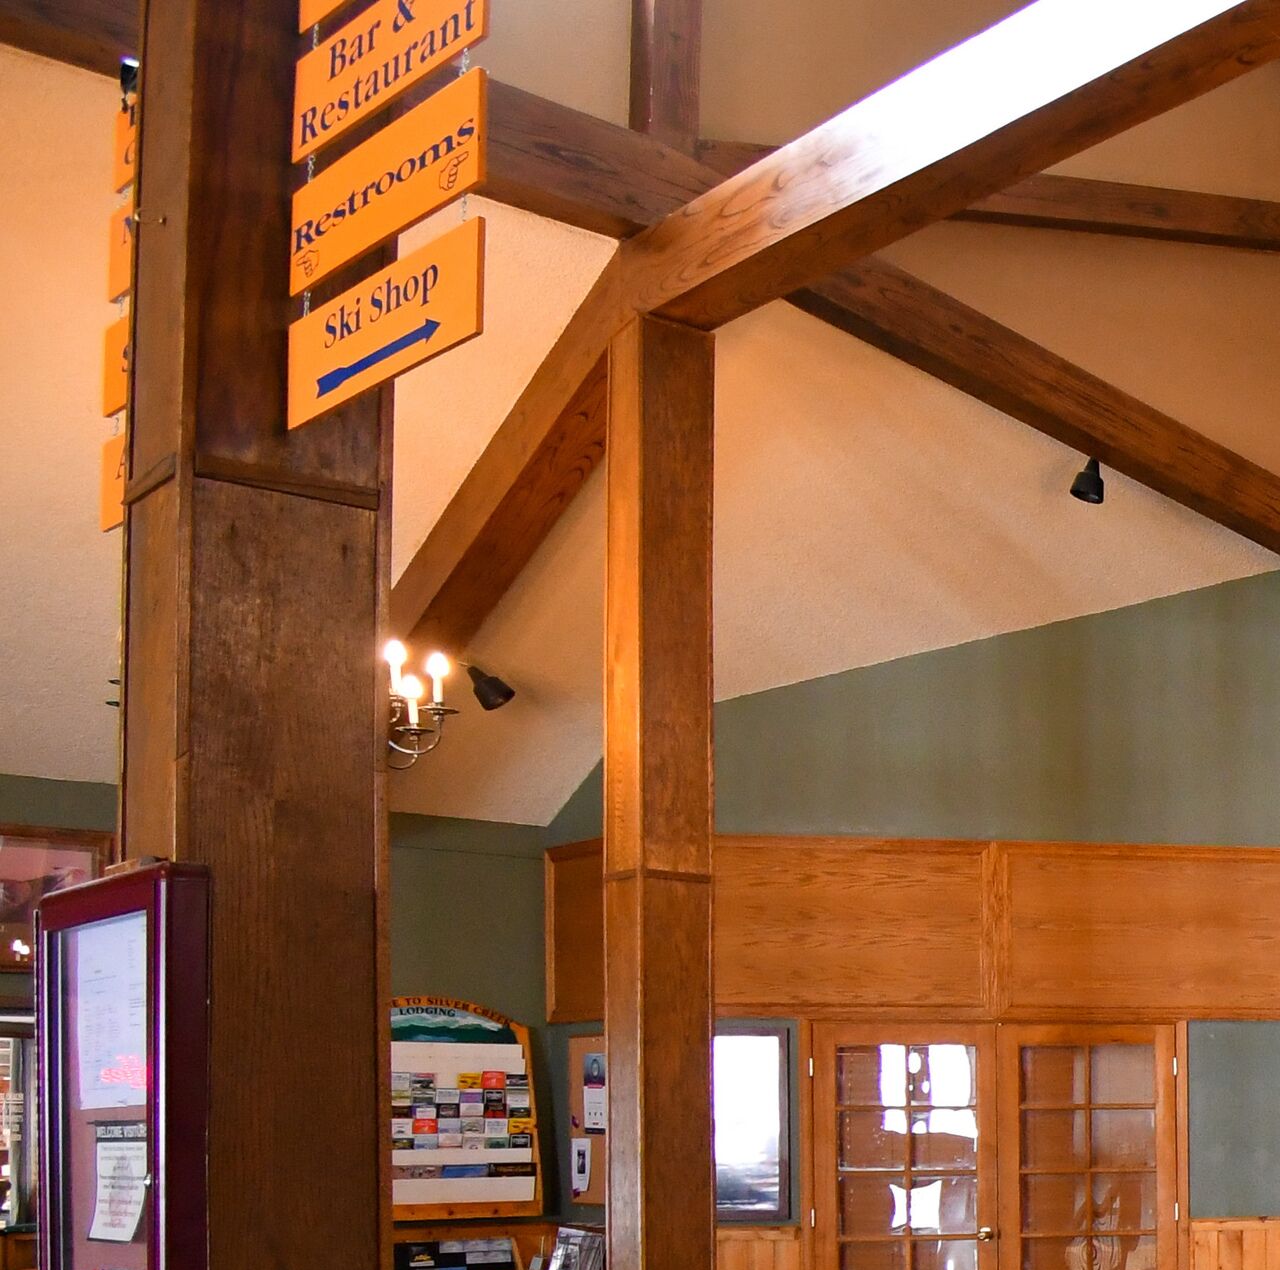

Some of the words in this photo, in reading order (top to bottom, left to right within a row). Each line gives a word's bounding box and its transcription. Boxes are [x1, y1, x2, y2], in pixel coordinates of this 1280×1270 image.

[299, 0, 477, 149] Restaurant
[327, 19, 382, 82] Bar
[392, 0, 416, 33] &
[292, 117, 475, 256] Restrooms
[323, 297, 363, 349] Ski
[369, 263, 439, 324] Shop
[399, 1007, 456, 1018] LODGING
